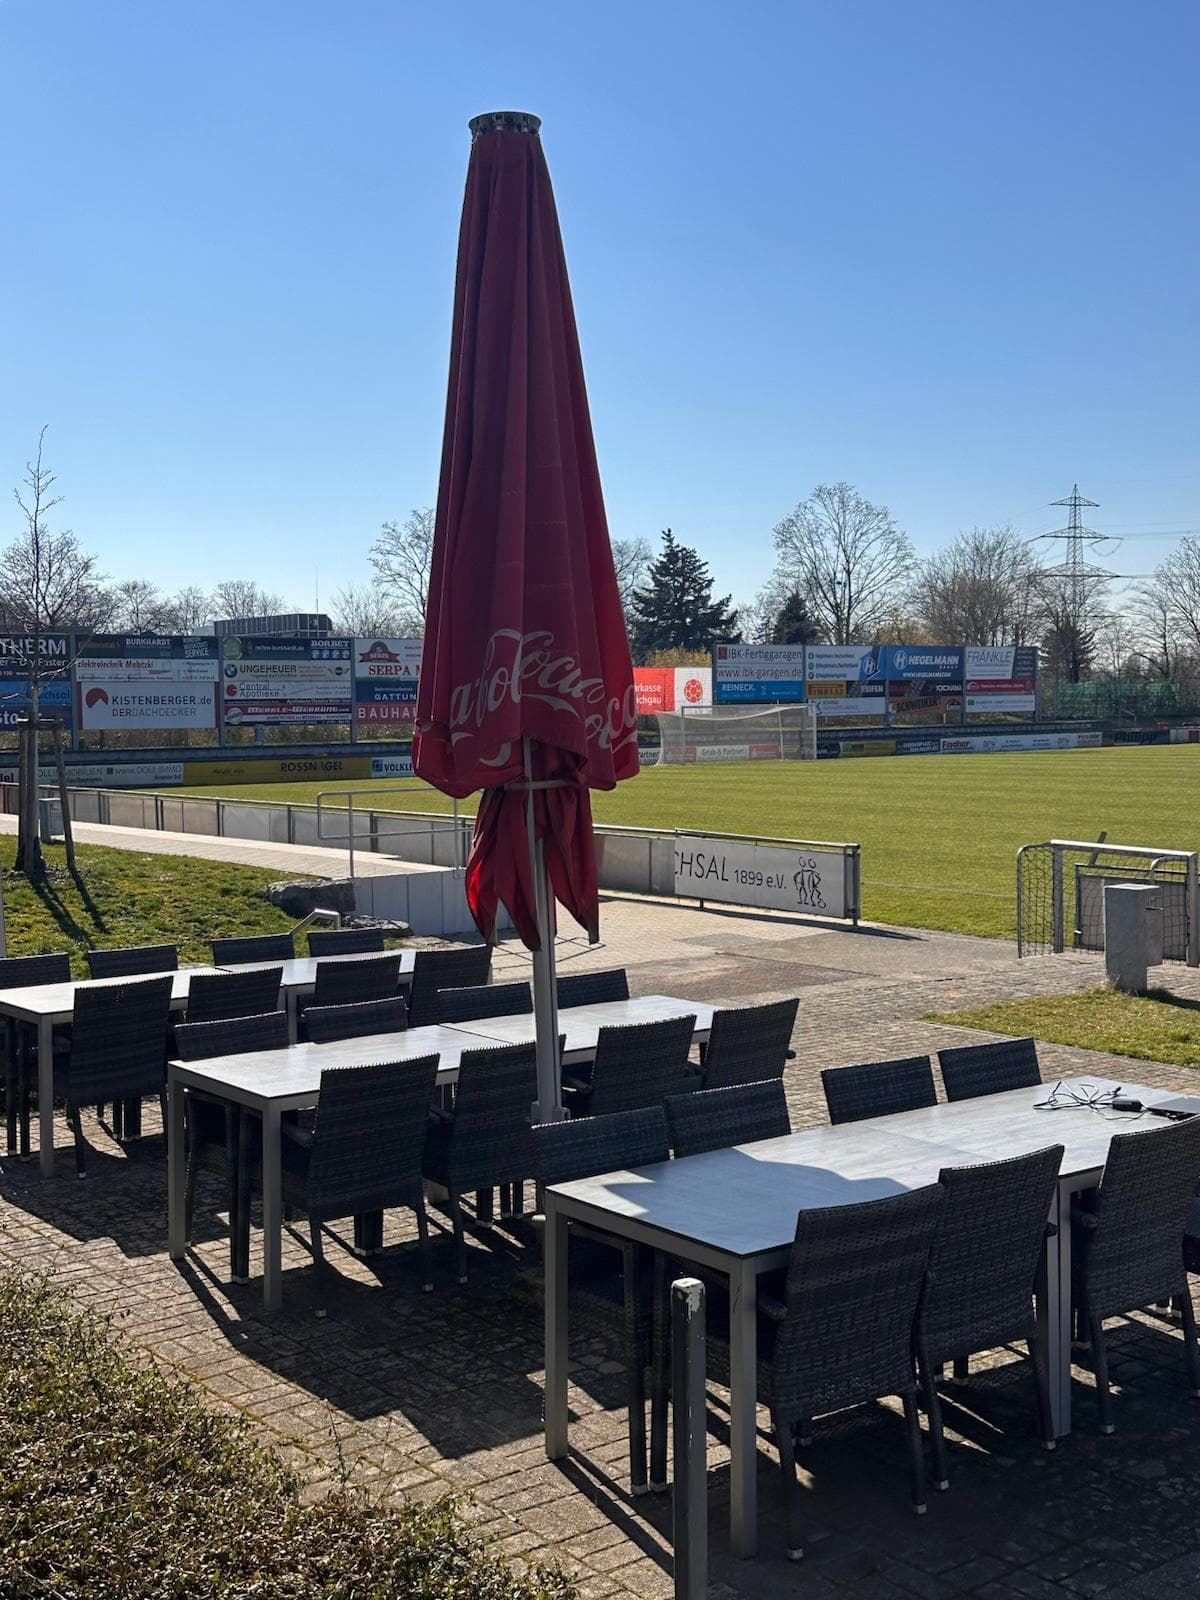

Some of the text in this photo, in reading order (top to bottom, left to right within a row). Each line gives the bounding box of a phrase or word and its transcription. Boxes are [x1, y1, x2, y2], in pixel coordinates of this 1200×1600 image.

[126, 638, 171, 646] BURKHARDT
[311, 639, 350, 647] BORBET
[728, 649, 802, 662] IBK-Fertiggaragen
[908, 655, 960, 665] HEGELMANN
[240, 664, 298, 674] UNGEHEUER
[368, 665, 412, 676] SERPA
[718, 667, 802, 681] www.ibk-garagen.de
[240, 682, 270, 691] Central
[861, 685, 884, 694] REIFEN
[240, 690, 280, 700] Apotheke
[112, 695, 212, 706] KISTENBERGER.de
[112, 707, 196, 717] DERDACHDECKER
[734, 869, 763, 886] 1899
[766, 873, 787, 889] e.V.
